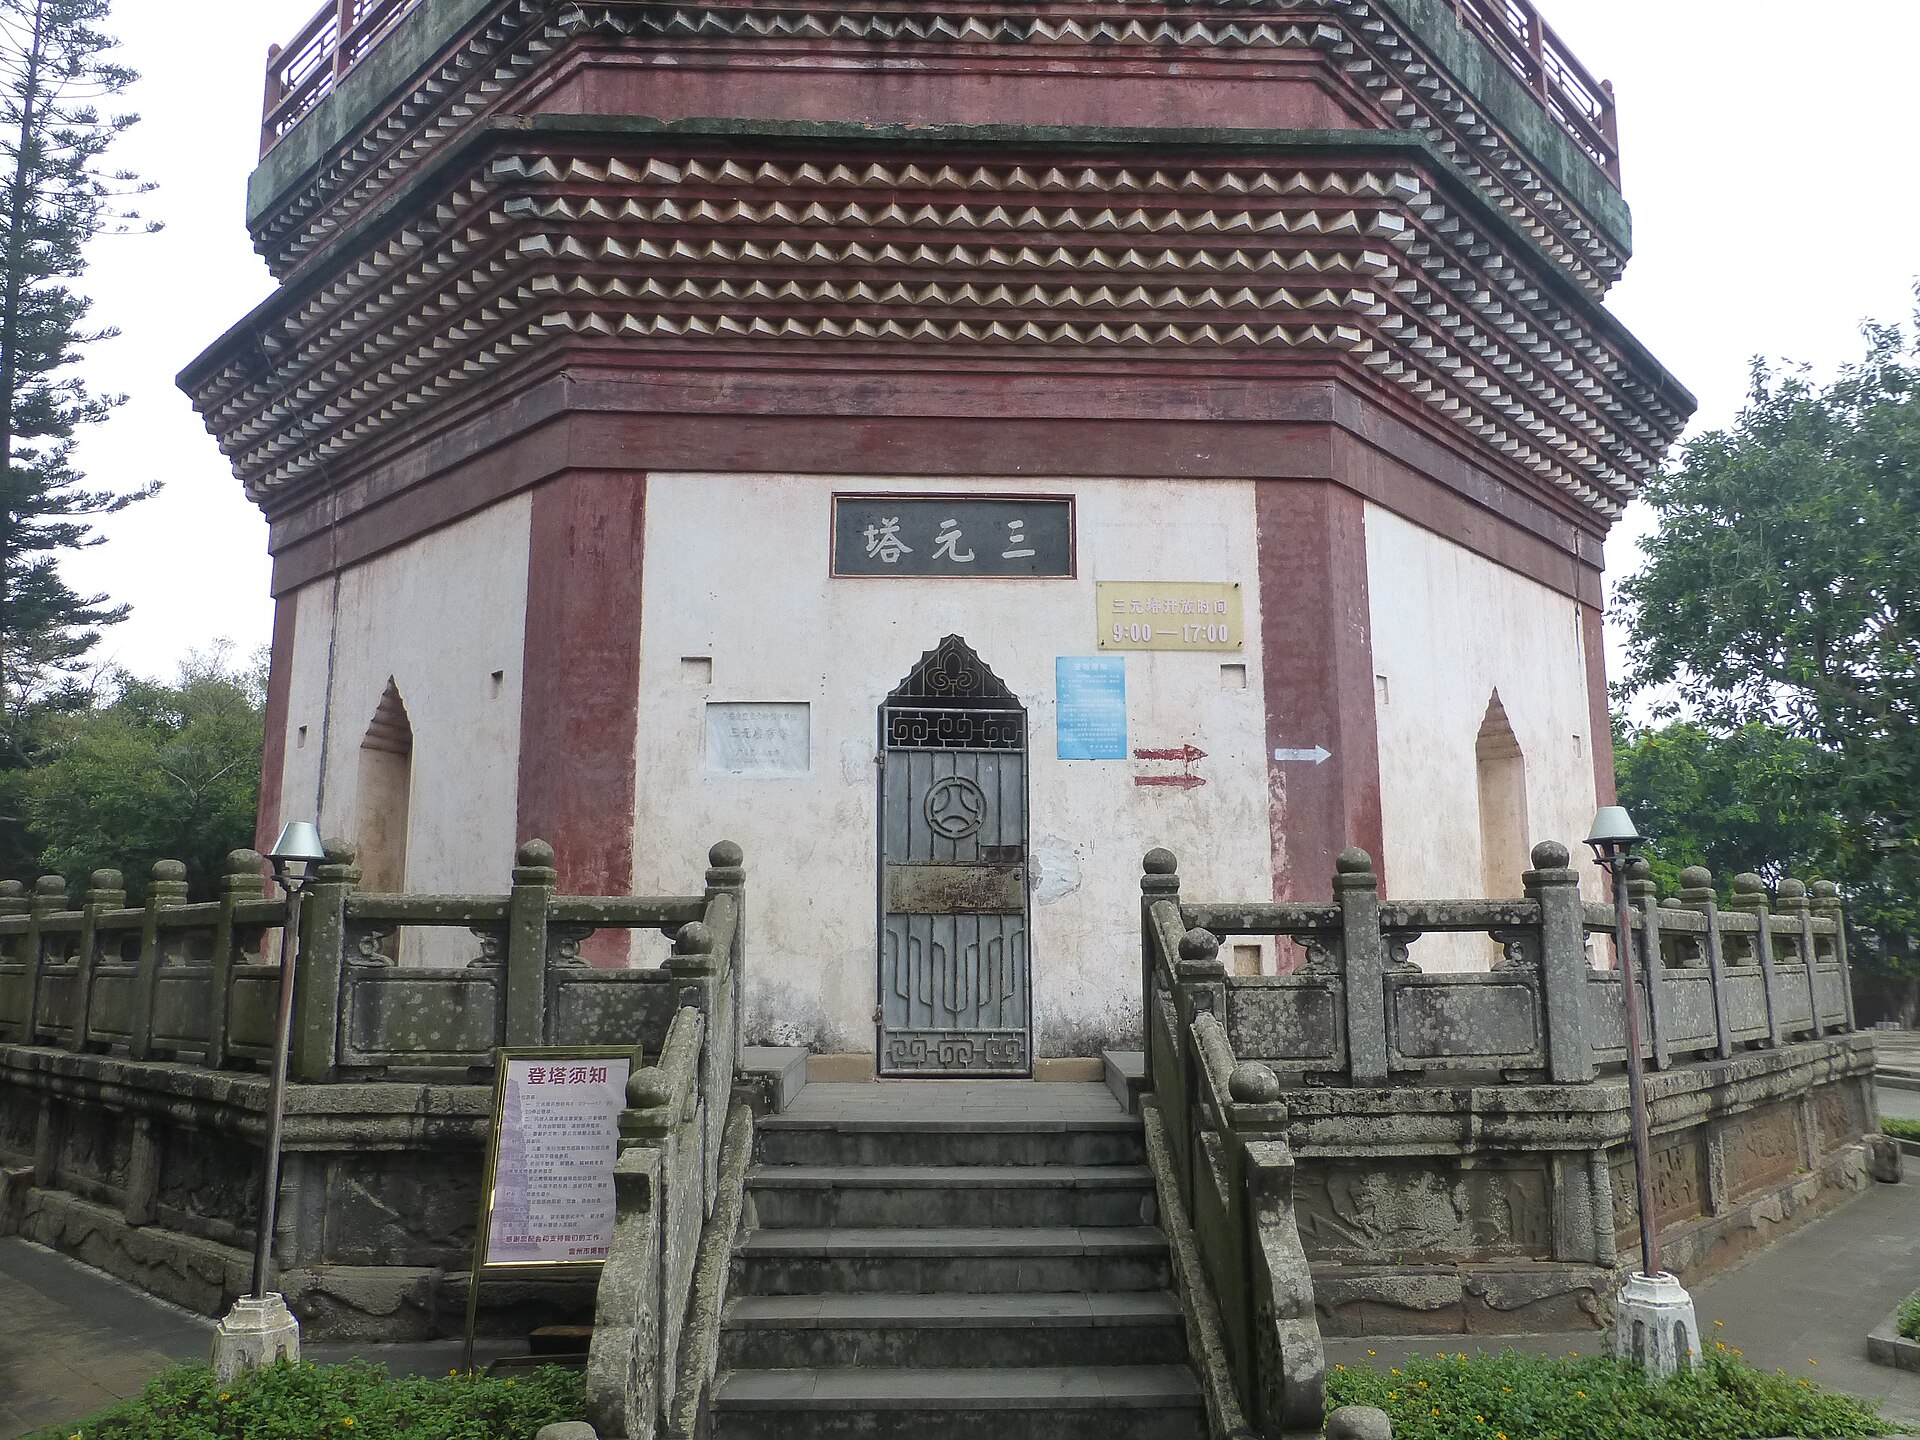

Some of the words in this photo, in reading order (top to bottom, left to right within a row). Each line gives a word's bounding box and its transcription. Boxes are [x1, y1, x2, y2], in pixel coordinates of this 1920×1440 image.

[1113, 598, 1228, 616] 三元塔开放时间
[527, 1066, 608, 1085] 登塔须知
